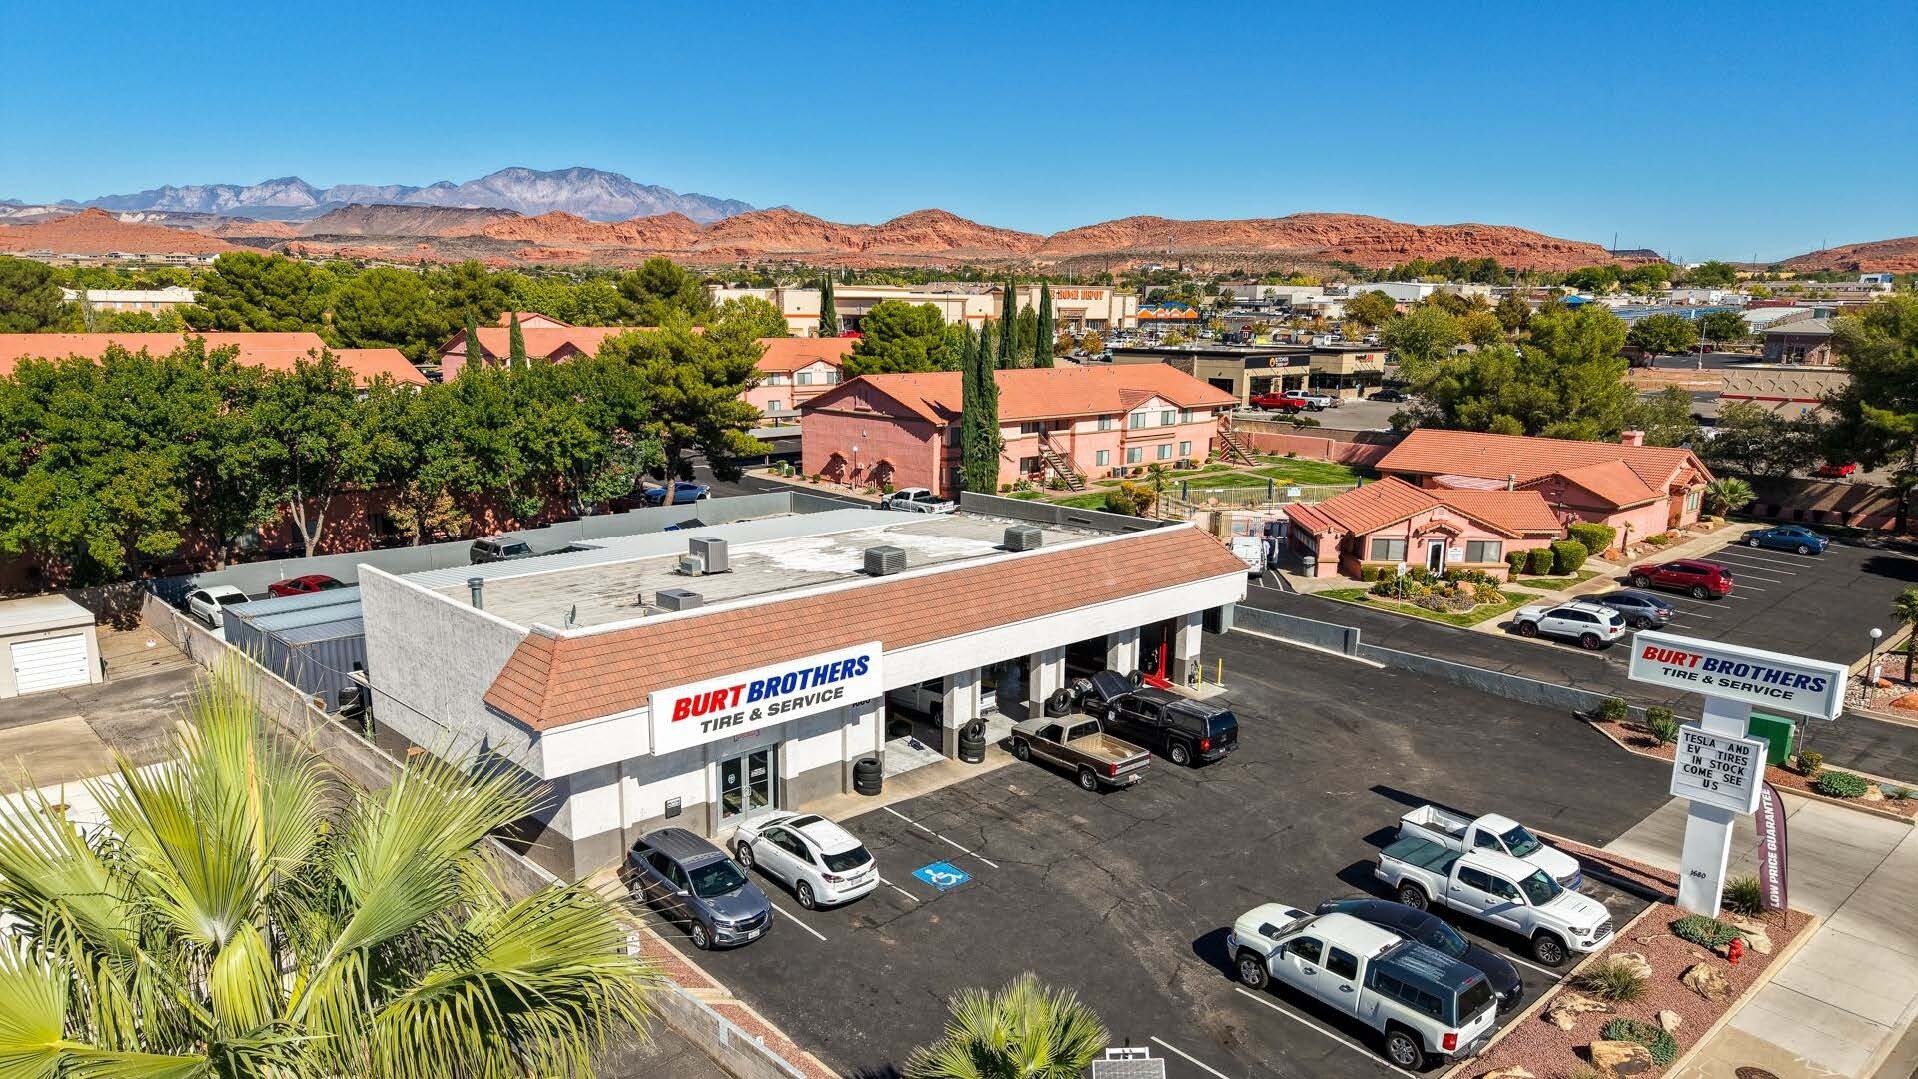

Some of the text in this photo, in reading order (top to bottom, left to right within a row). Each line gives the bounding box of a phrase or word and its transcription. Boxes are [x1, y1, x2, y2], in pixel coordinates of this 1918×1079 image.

[1641, 646, 1827, 693] BURT BROTHERS
[1662, 667, 1794, 700] TIRE & SERVICE
[671, 655, 870, 722] BURT BROTHERS
[700, 711, 745, 733] TIRE
[749, 708, 763, 721] &
[767, 686, 845, 718] SERVICE
[1684, 732, 1750, 755] TESLA AND
[1687, 744, 1748, 766] EV TIRES
[1683, 764, 1742, 786] COME SEE
[1692, 755, 1744, 776] IN STOCK
[1703, 779, 1719, 791] US
[1762, 788, 1779, 908] LOW PRICE GUARANTEE
